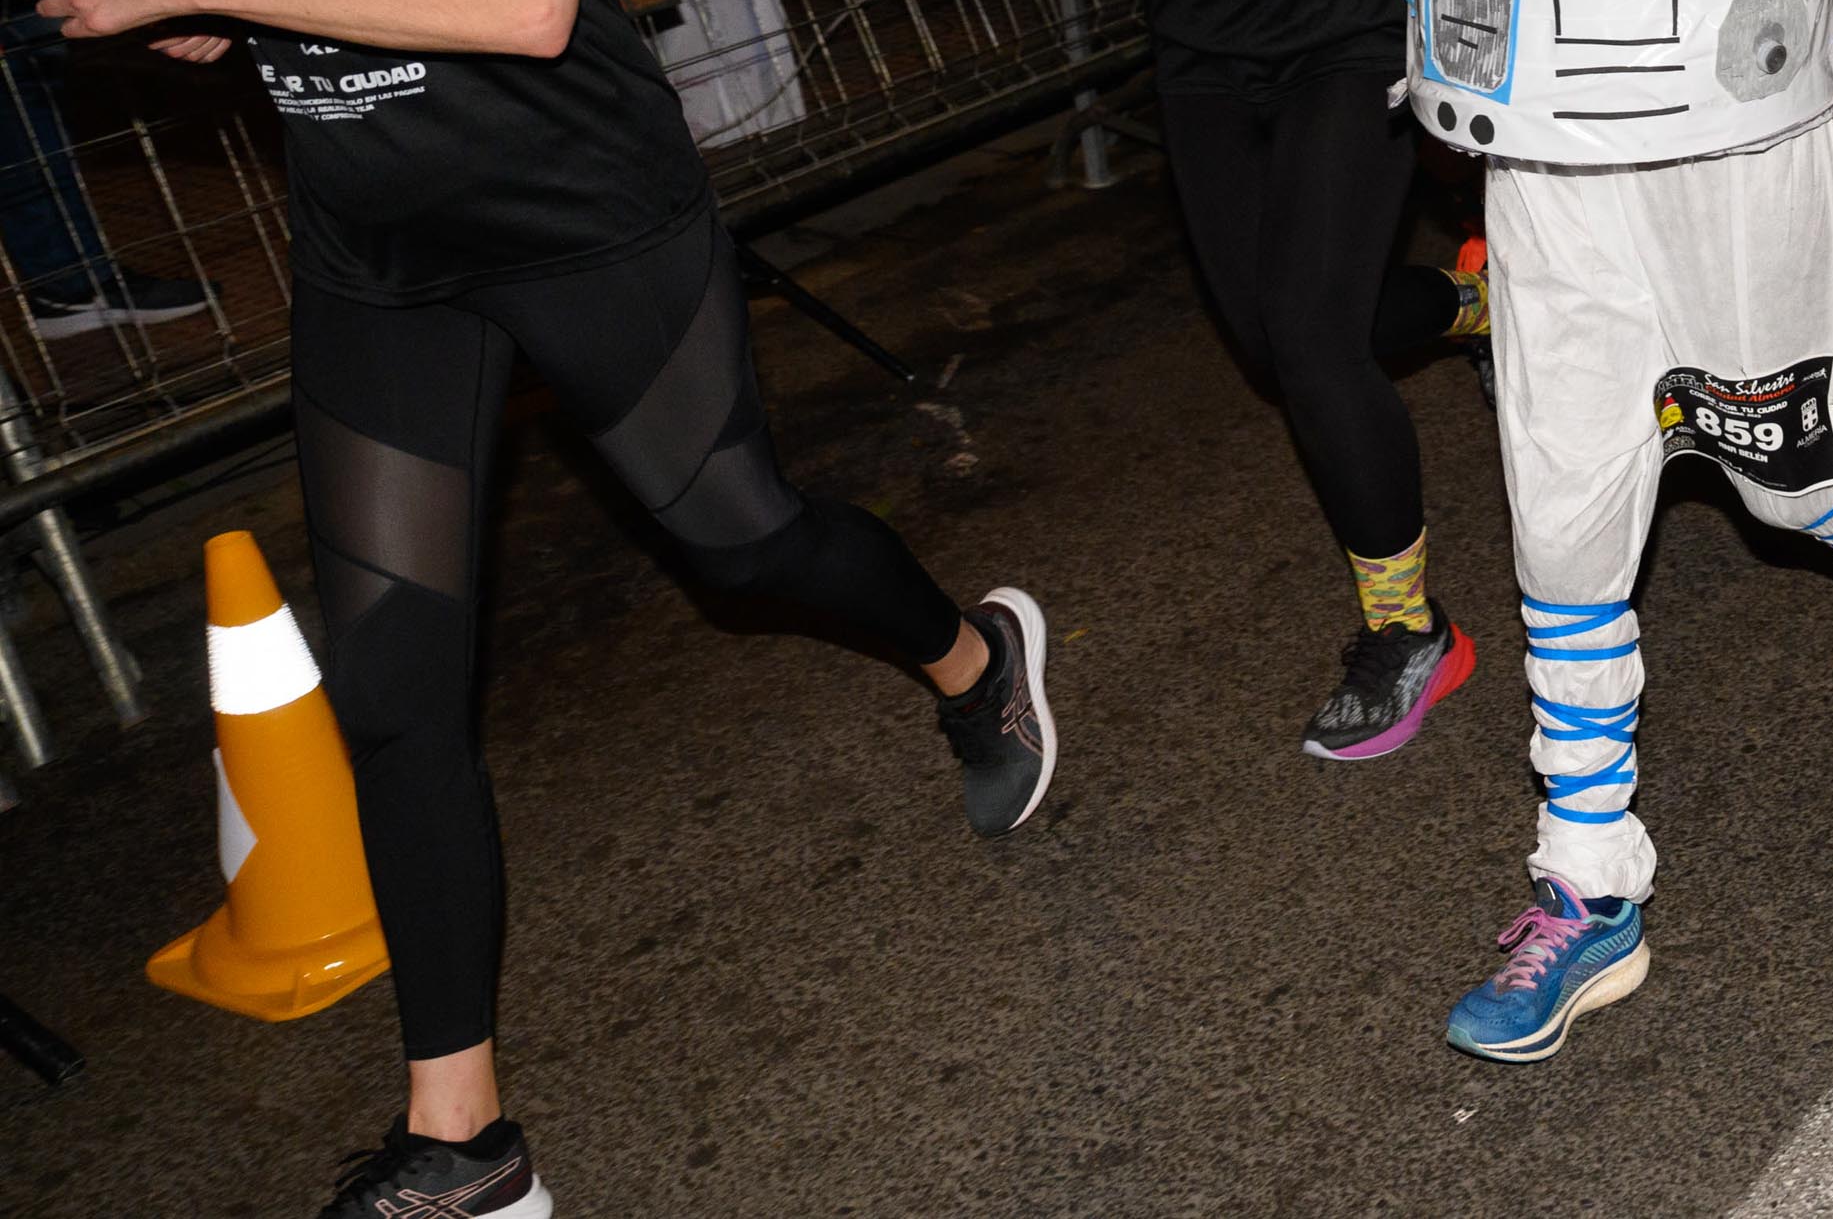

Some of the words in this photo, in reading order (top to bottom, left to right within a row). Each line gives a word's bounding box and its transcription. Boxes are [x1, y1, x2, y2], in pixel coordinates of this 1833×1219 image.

[309, 75, 335, 93] TU
[339, 61, 427, 93] CIUDAD
[1704, 374, 1730, 393] San
[1736, 372, 1796, 395] Silvestre
[1719, 402, 1738, 412] POR
[1740, 406, 1754, 414] TU
[1757, 401, 1788, 414] CIUDAD
[1695, 407, 1784, 452] 859
[1738, 449, 1768, 464] BELÉN
